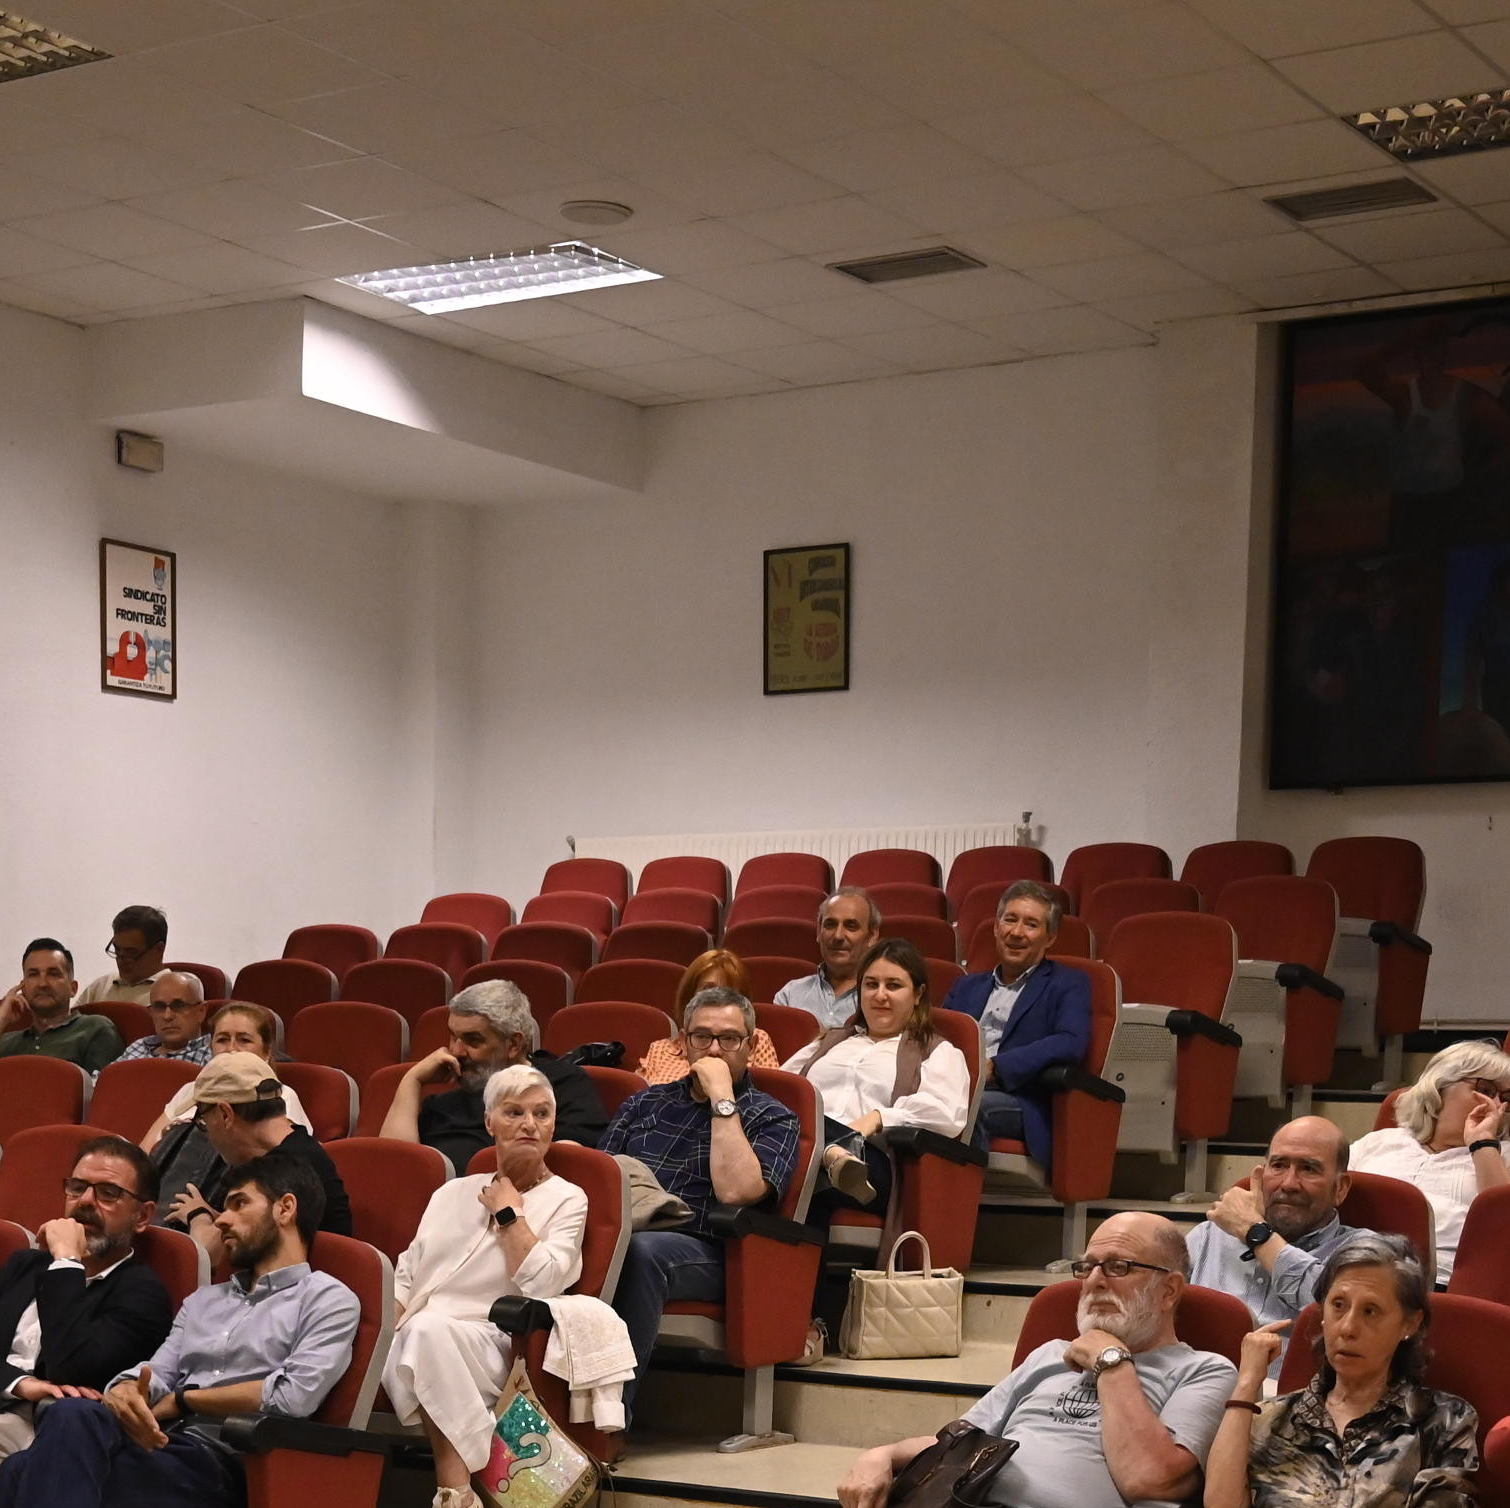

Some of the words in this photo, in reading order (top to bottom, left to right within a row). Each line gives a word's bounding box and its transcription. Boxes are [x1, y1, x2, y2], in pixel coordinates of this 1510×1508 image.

[123, 587, 166, 604] SINDICATO
[116, 608, 166, 627] FRONTERAS
[153, 604, 166, 616] SIN
